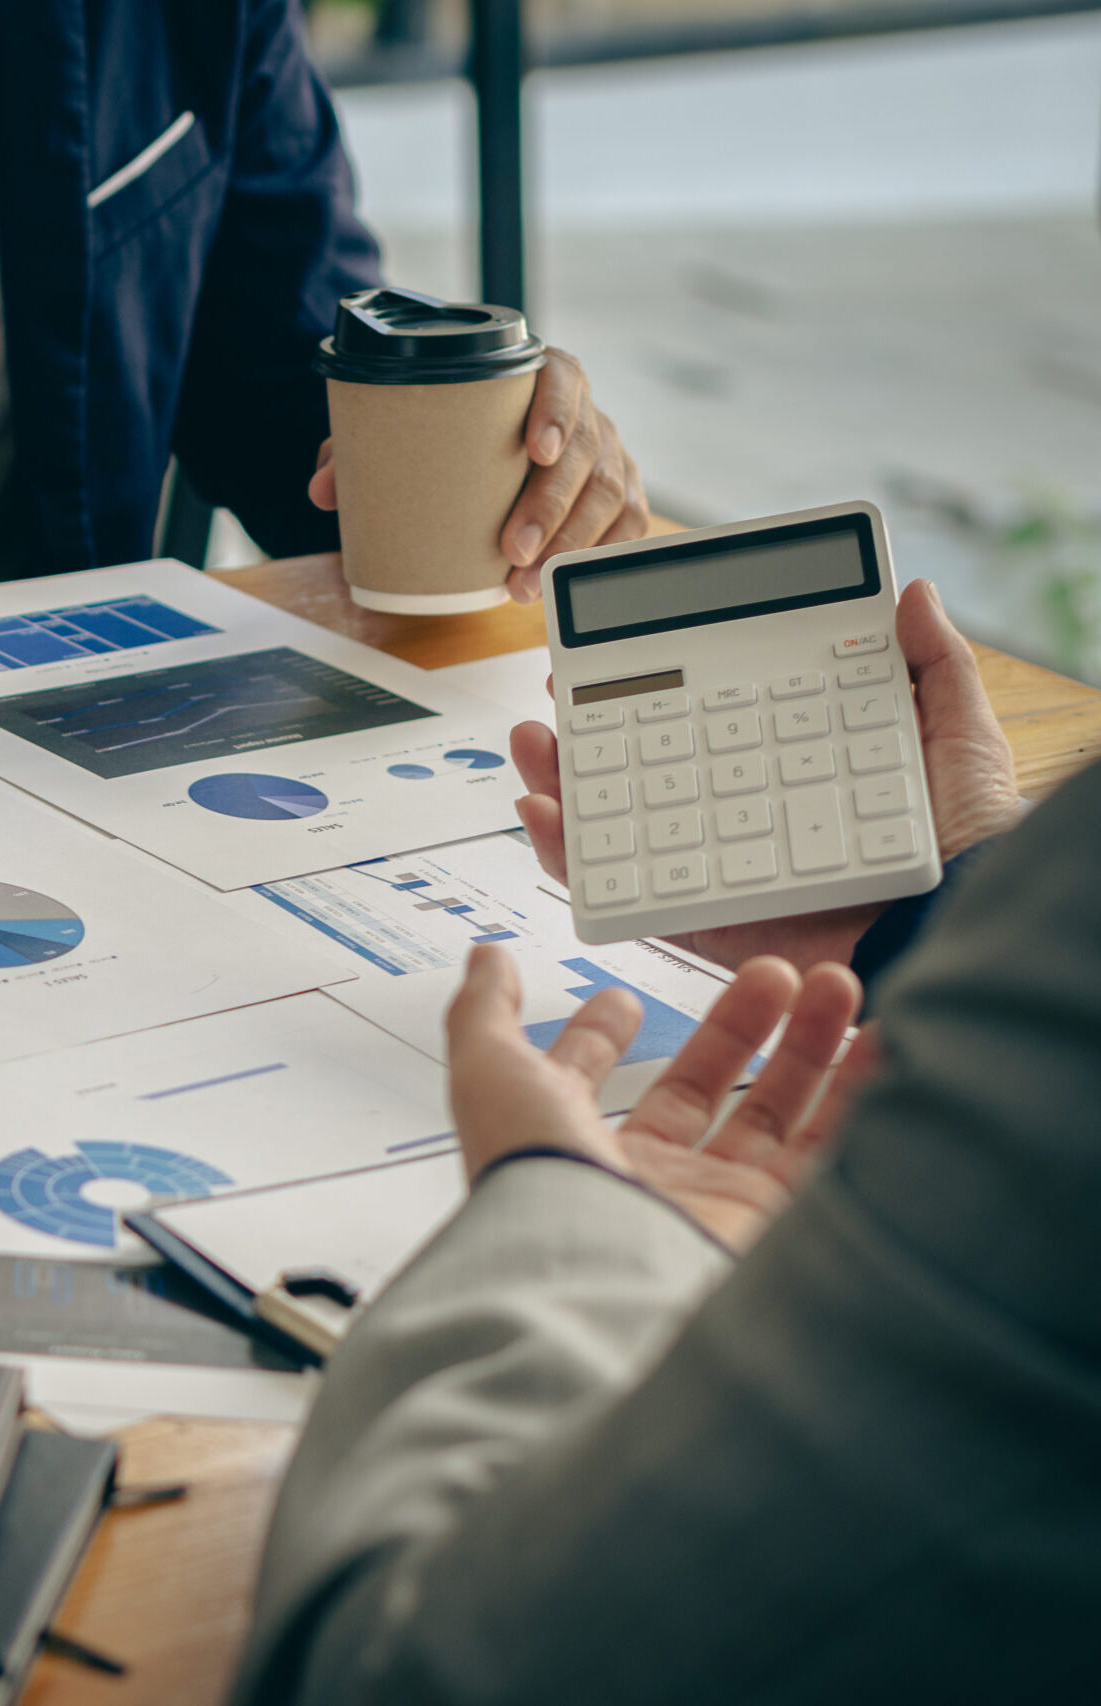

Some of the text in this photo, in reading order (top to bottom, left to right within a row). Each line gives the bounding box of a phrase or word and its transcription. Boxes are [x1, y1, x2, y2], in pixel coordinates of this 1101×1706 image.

[843, 634, 877, 649] ON/AC
[856, 665, 872, 676] CE
[788, 676, 803, 688] GT
[717, 687, 741, 700] MRC
[585, 711, 606, 724] M+
[793, 711, 810, 724] %
[727, 722, 739, 736] 9
[660, 734, 672, 748] 8
[594, 745, 604, 760] 7
[732, 765, 744, 779] 6
[664, 779, 676, 791] 5
[597, 788, 609, 802] 4
[738, 810, 749, 824] 3
[307, 823, 343, 833] SALES
[669, 822, 681, 836] 2
[604, 832, 611, 846] 1
[670, 865, 689, 880] 00
[606, 877, 617, 892] 0
[658, 951, 698, 972] SALES
